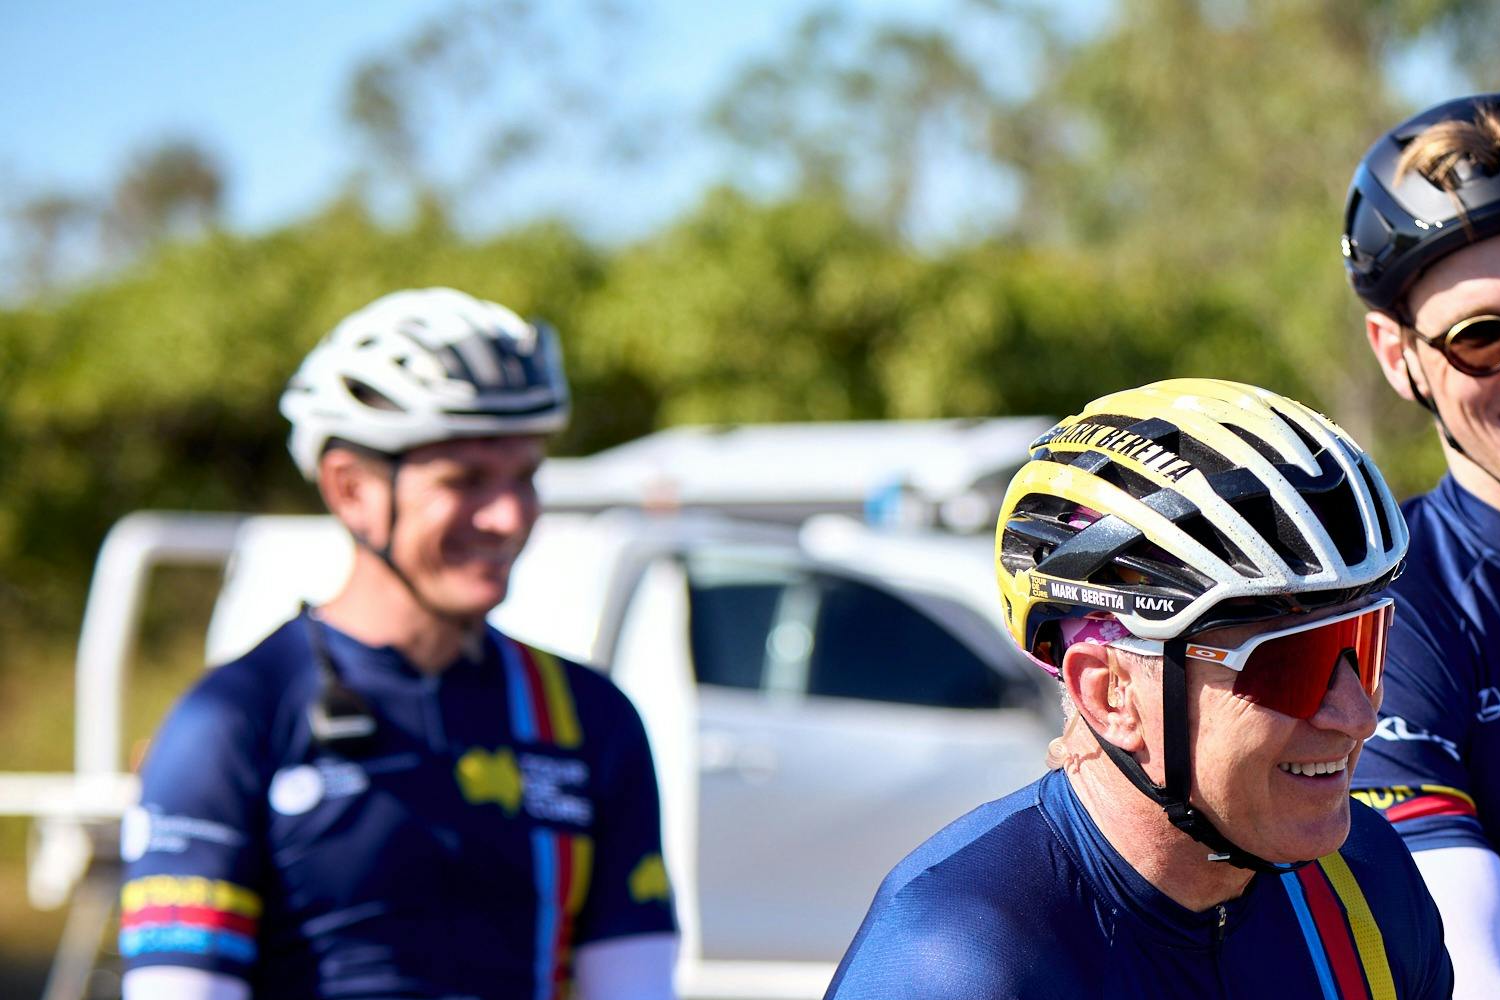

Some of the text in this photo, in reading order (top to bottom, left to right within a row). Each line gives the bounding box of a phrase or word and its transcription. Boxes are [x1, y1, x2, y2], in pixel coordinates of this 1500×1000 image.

[1095, 427, 1196, 484] BERETTA
[1050, 582, 1125, 610] MARK BERETTA
[1135, 596, 1175, 613] KASK
